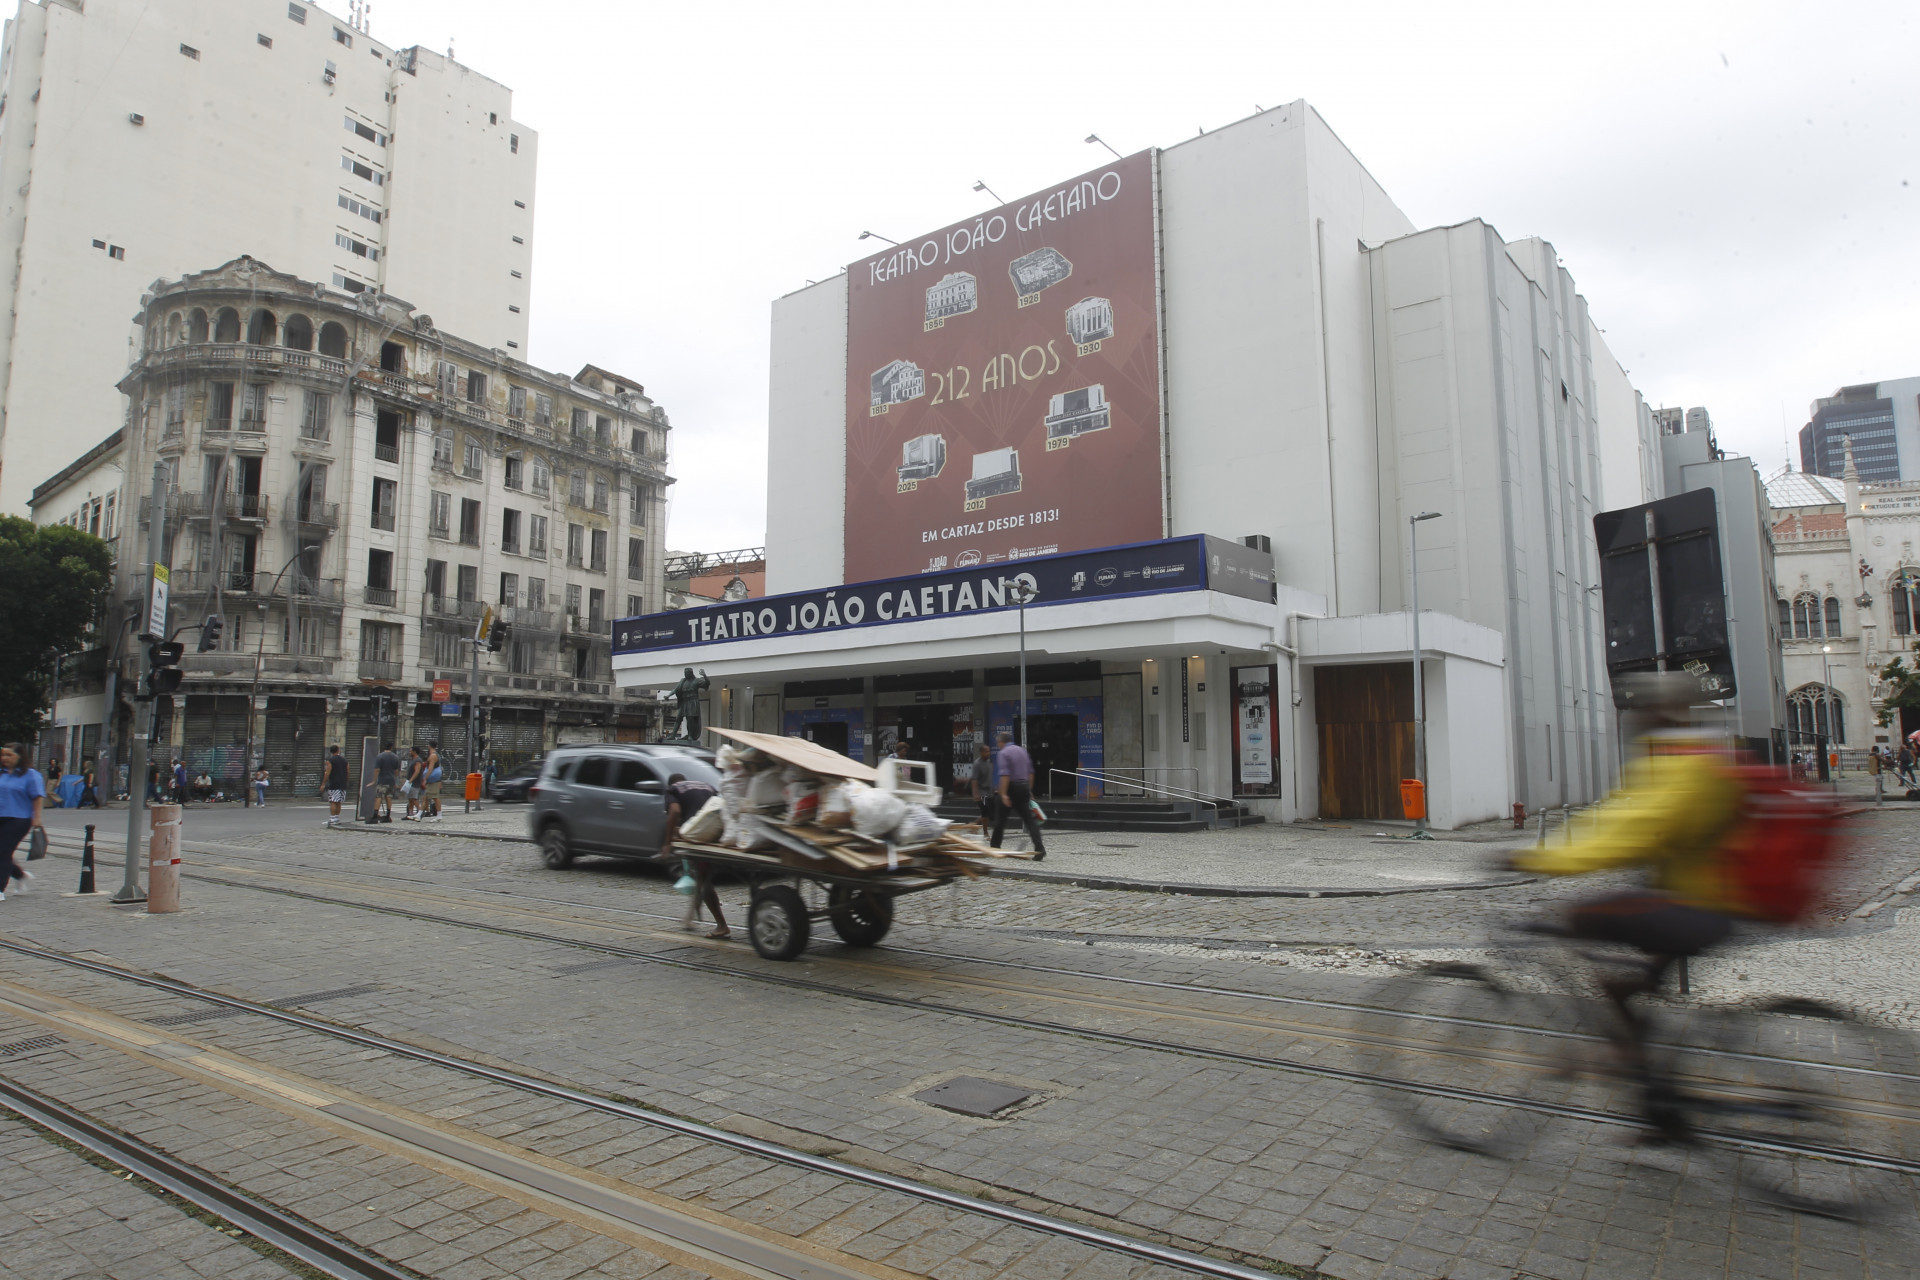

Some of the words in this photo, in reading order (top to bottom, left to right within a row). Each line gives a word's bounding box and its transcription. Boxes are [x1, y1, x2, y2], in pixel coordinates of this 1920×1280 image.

[868, 239, 939, 286] TEATRO
[944, 216, 1007, 264] JOÃO
[1015, 171, 1121, 232] CAETANO
[1019, 293, 1039, 306] 1928
[925, 318, 944, 330] 1856
[1078, 342, 1100, 355] 1930
[930, 365, 971, 406] 212
[982, 339, 1060, 392] ANOS
[871, 404, 888, 415] 1813
[1047, 438, 1068, 449] 1979
[897, 482, 917, 491] 2025
[965, 500, 985, 510] 2012
[921, 530, 939, 543] EM
[941, 522, 984, 540] CARTAZ
[987, 515, 1025, 531] DESDE
[1029, 508, 1060, 525] 1813!
[1036, 547, 1058, 555] JANEIRO
[688, 608, 777, 642] TEATRO
[786, 592, 865, 631] JOÃO
[876, 573, 1038, 620] CAETANO
